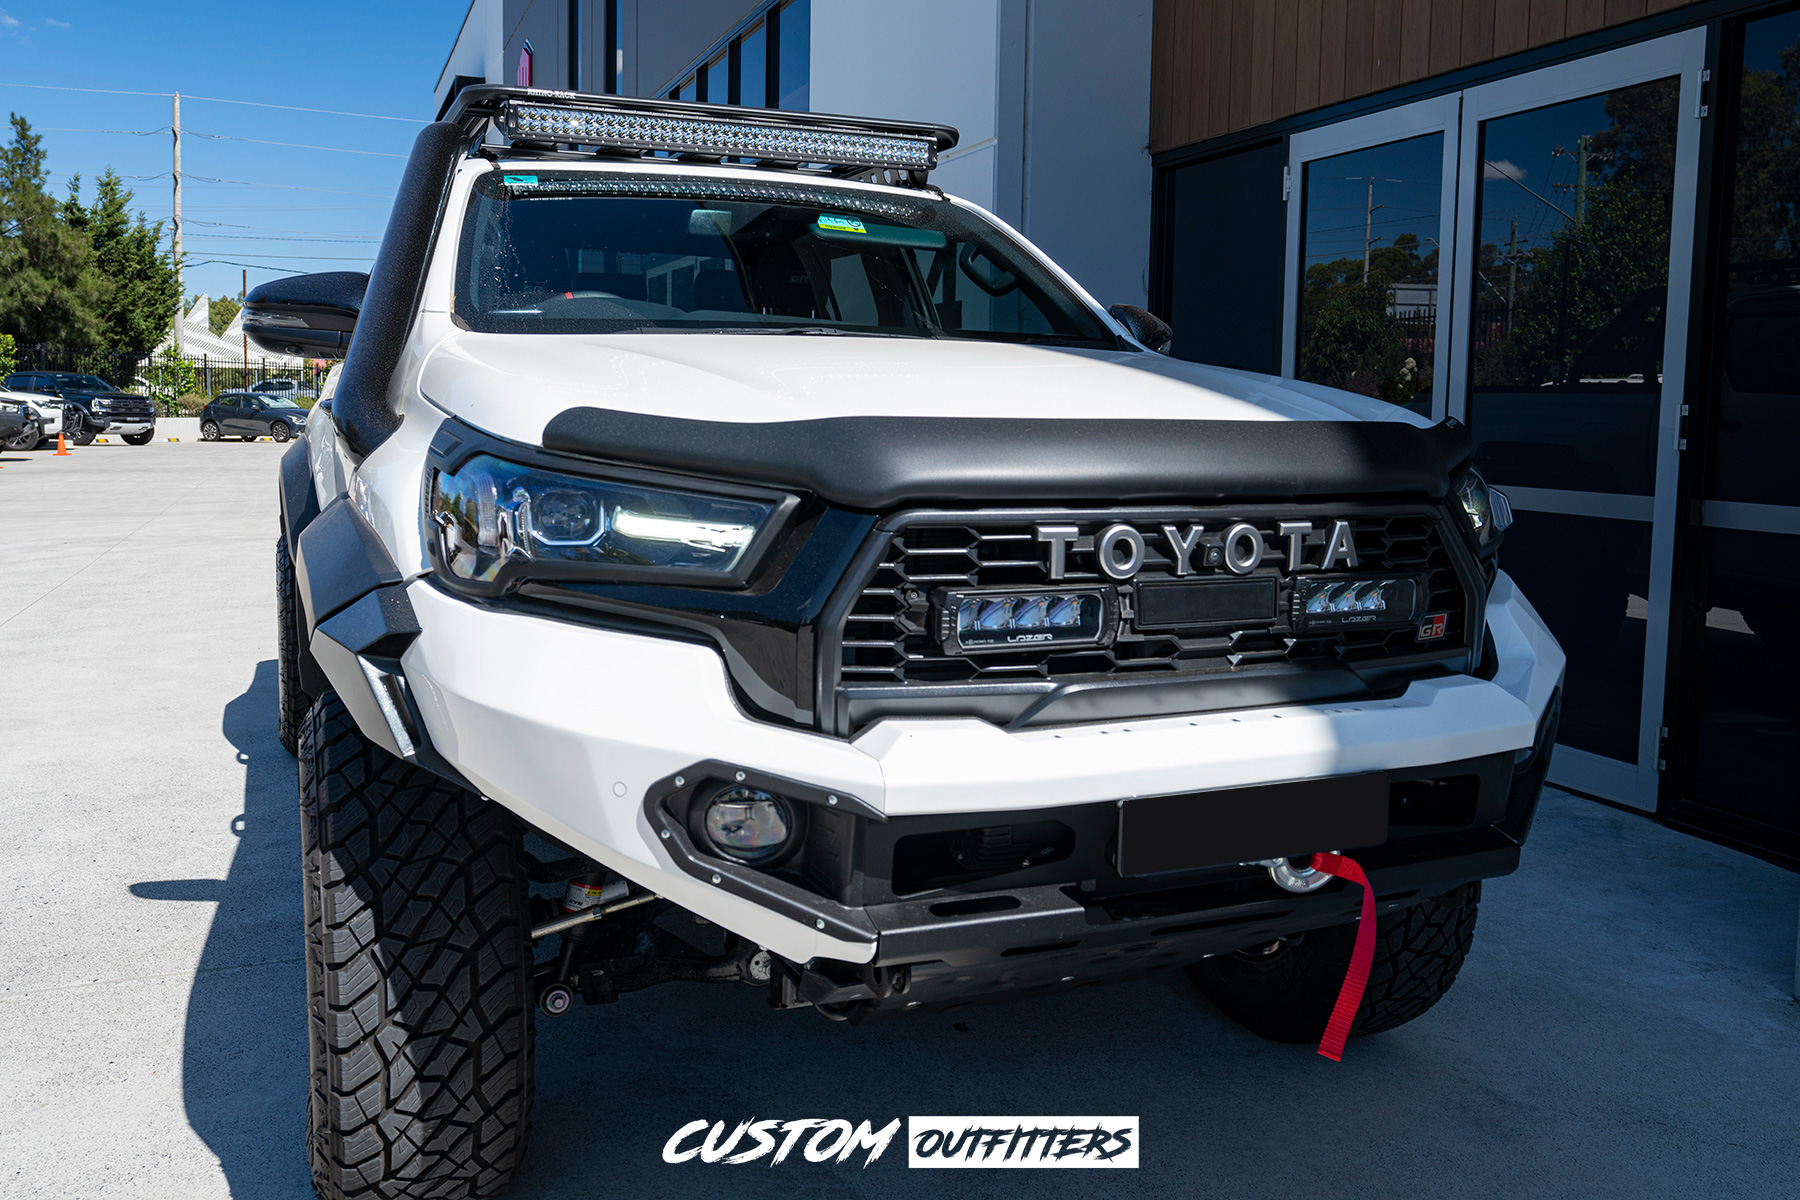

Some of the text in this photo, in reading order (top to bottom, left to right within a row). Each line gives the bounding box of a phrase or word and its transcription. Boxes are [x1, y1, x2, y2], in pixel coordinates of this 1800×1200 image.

[1035, 520, 1359, 580] TOYOTA
[1341, 615, 1377, 623] LAZER
[1420, 623, 1443, 637] GR
[1007, 633, 1053, 642] LAZER
